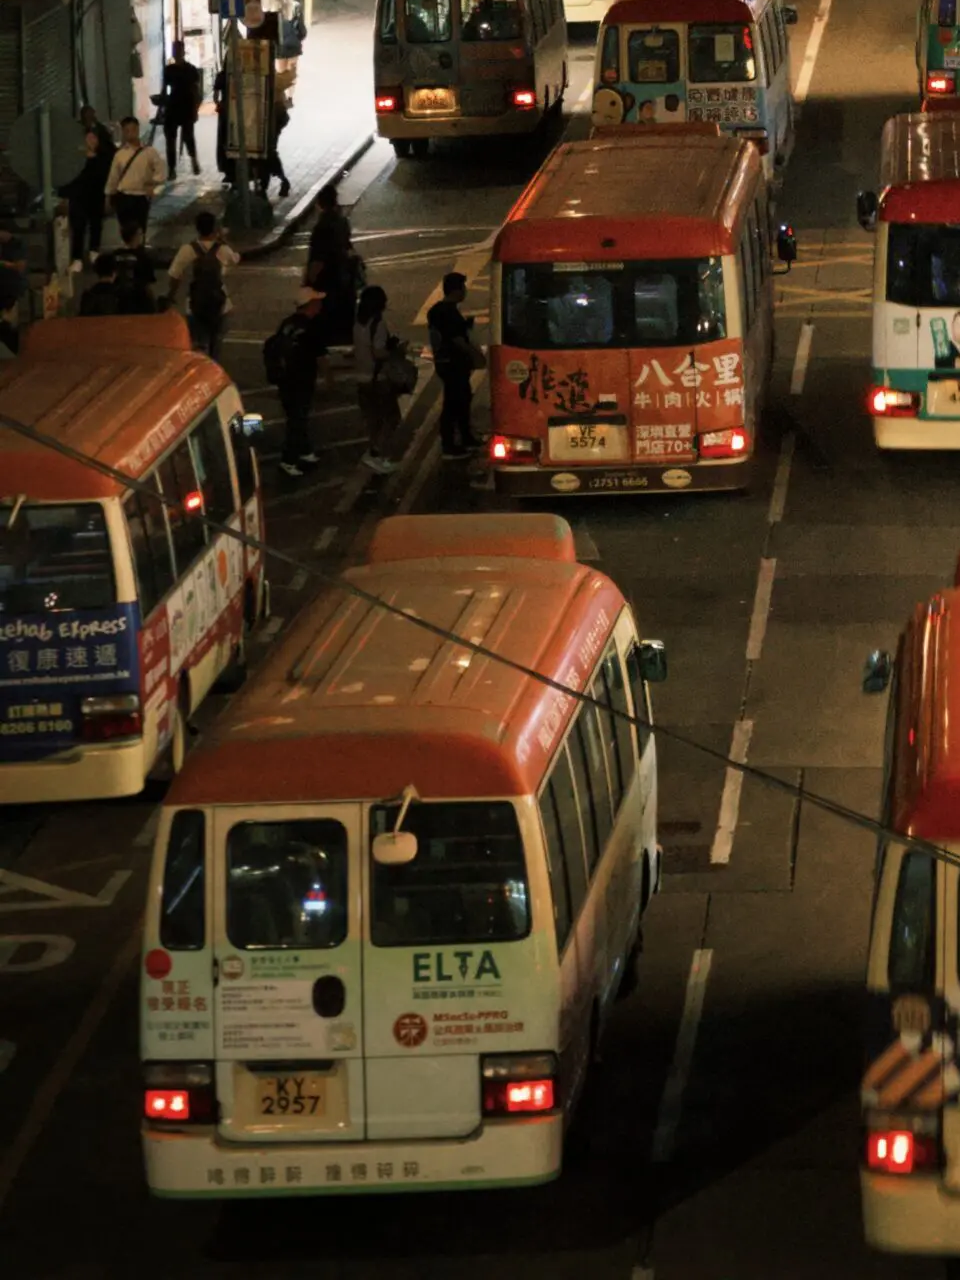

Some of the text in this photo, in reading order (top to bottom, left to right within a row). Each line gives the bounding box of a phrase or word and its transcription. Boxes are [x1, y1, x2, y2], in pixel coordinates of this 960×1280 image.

[634, 353, 741, 387] 八合里
[569, 436, 606, 448] 5574
[413, 949, 501, 982] ELTA
[276, 1076, 305, 1096] KY
[261, 1095, 320, 1115] 2957
